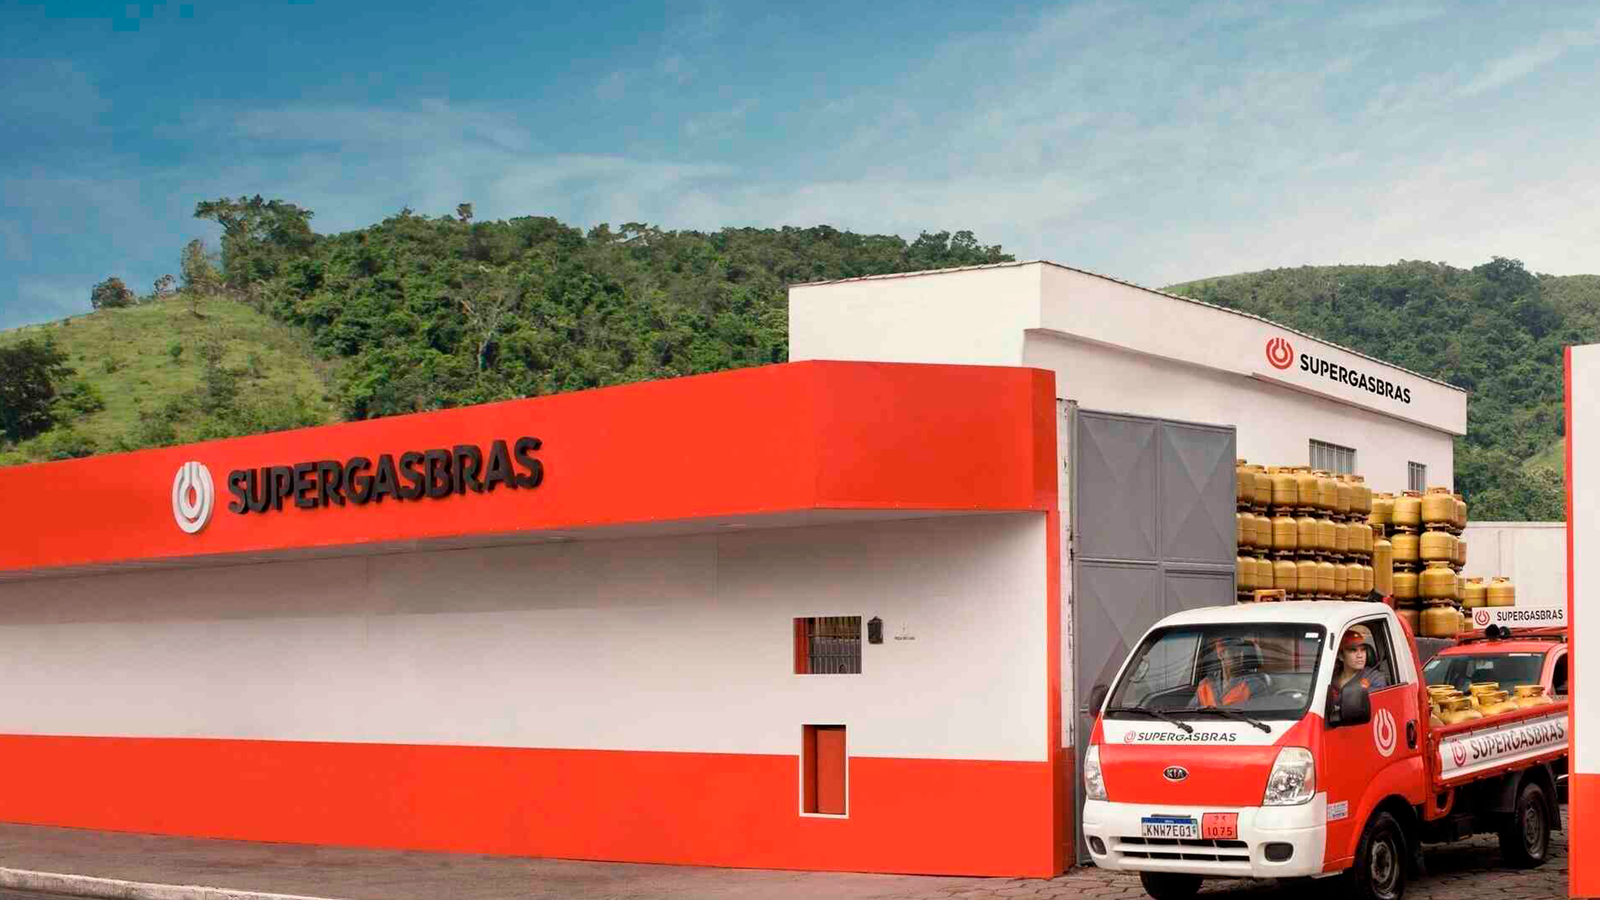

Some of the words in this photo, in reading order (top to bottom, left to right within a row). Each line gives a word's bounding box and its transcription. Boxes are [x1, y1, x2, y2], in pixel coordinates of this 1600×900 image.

[1300, 353, 1411, 404] SUPERGASBRAS
[227, 436, 544, 515] SUPERGASBRAS
[1496, 609, 1564, 621] SUPERGASBRAS
[1137, 732, 1237, 742] SUPERGASBRAS
[1470, 719, 1564, 759] SUPERGASBRAS
[1207, 826, 1233, 837] 1075
